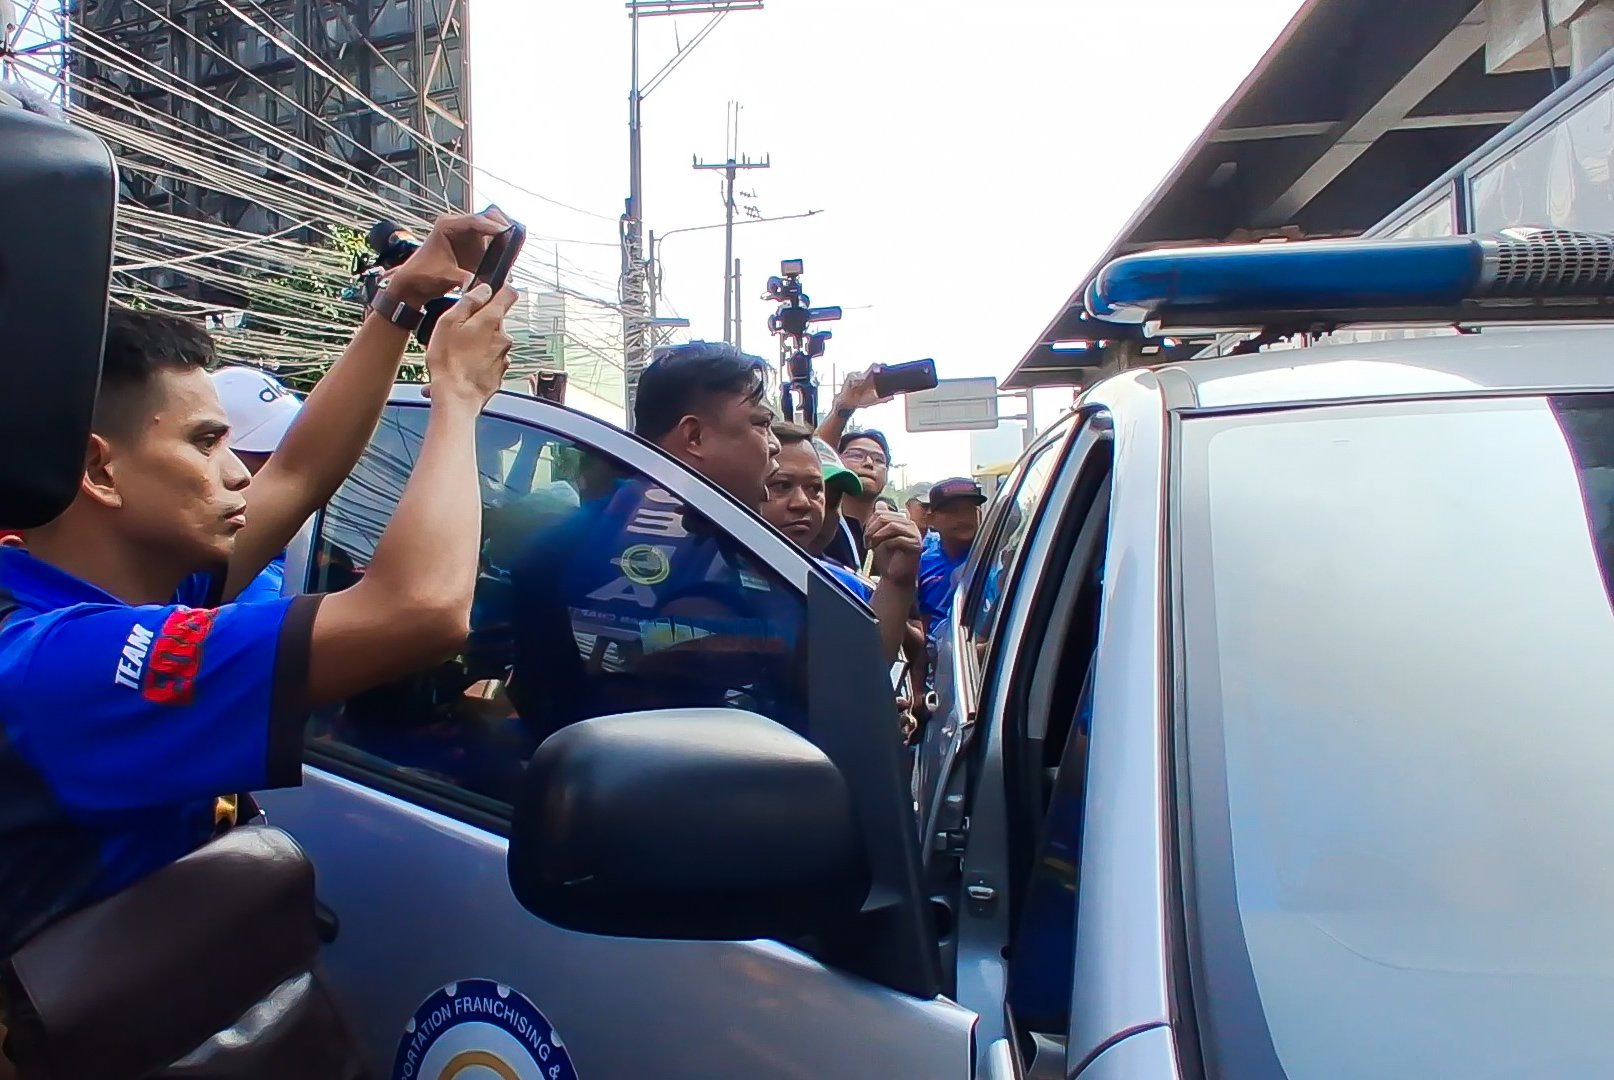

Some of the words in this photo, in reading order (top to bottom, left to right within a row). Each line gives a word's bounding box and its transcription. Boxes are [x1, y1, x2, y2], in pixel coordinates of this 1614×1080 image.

[114, 623, 155, 690] TEAM
[454, 996, 551, 1063] FRANCHISING
[548, 1064, 561, 1080] &
